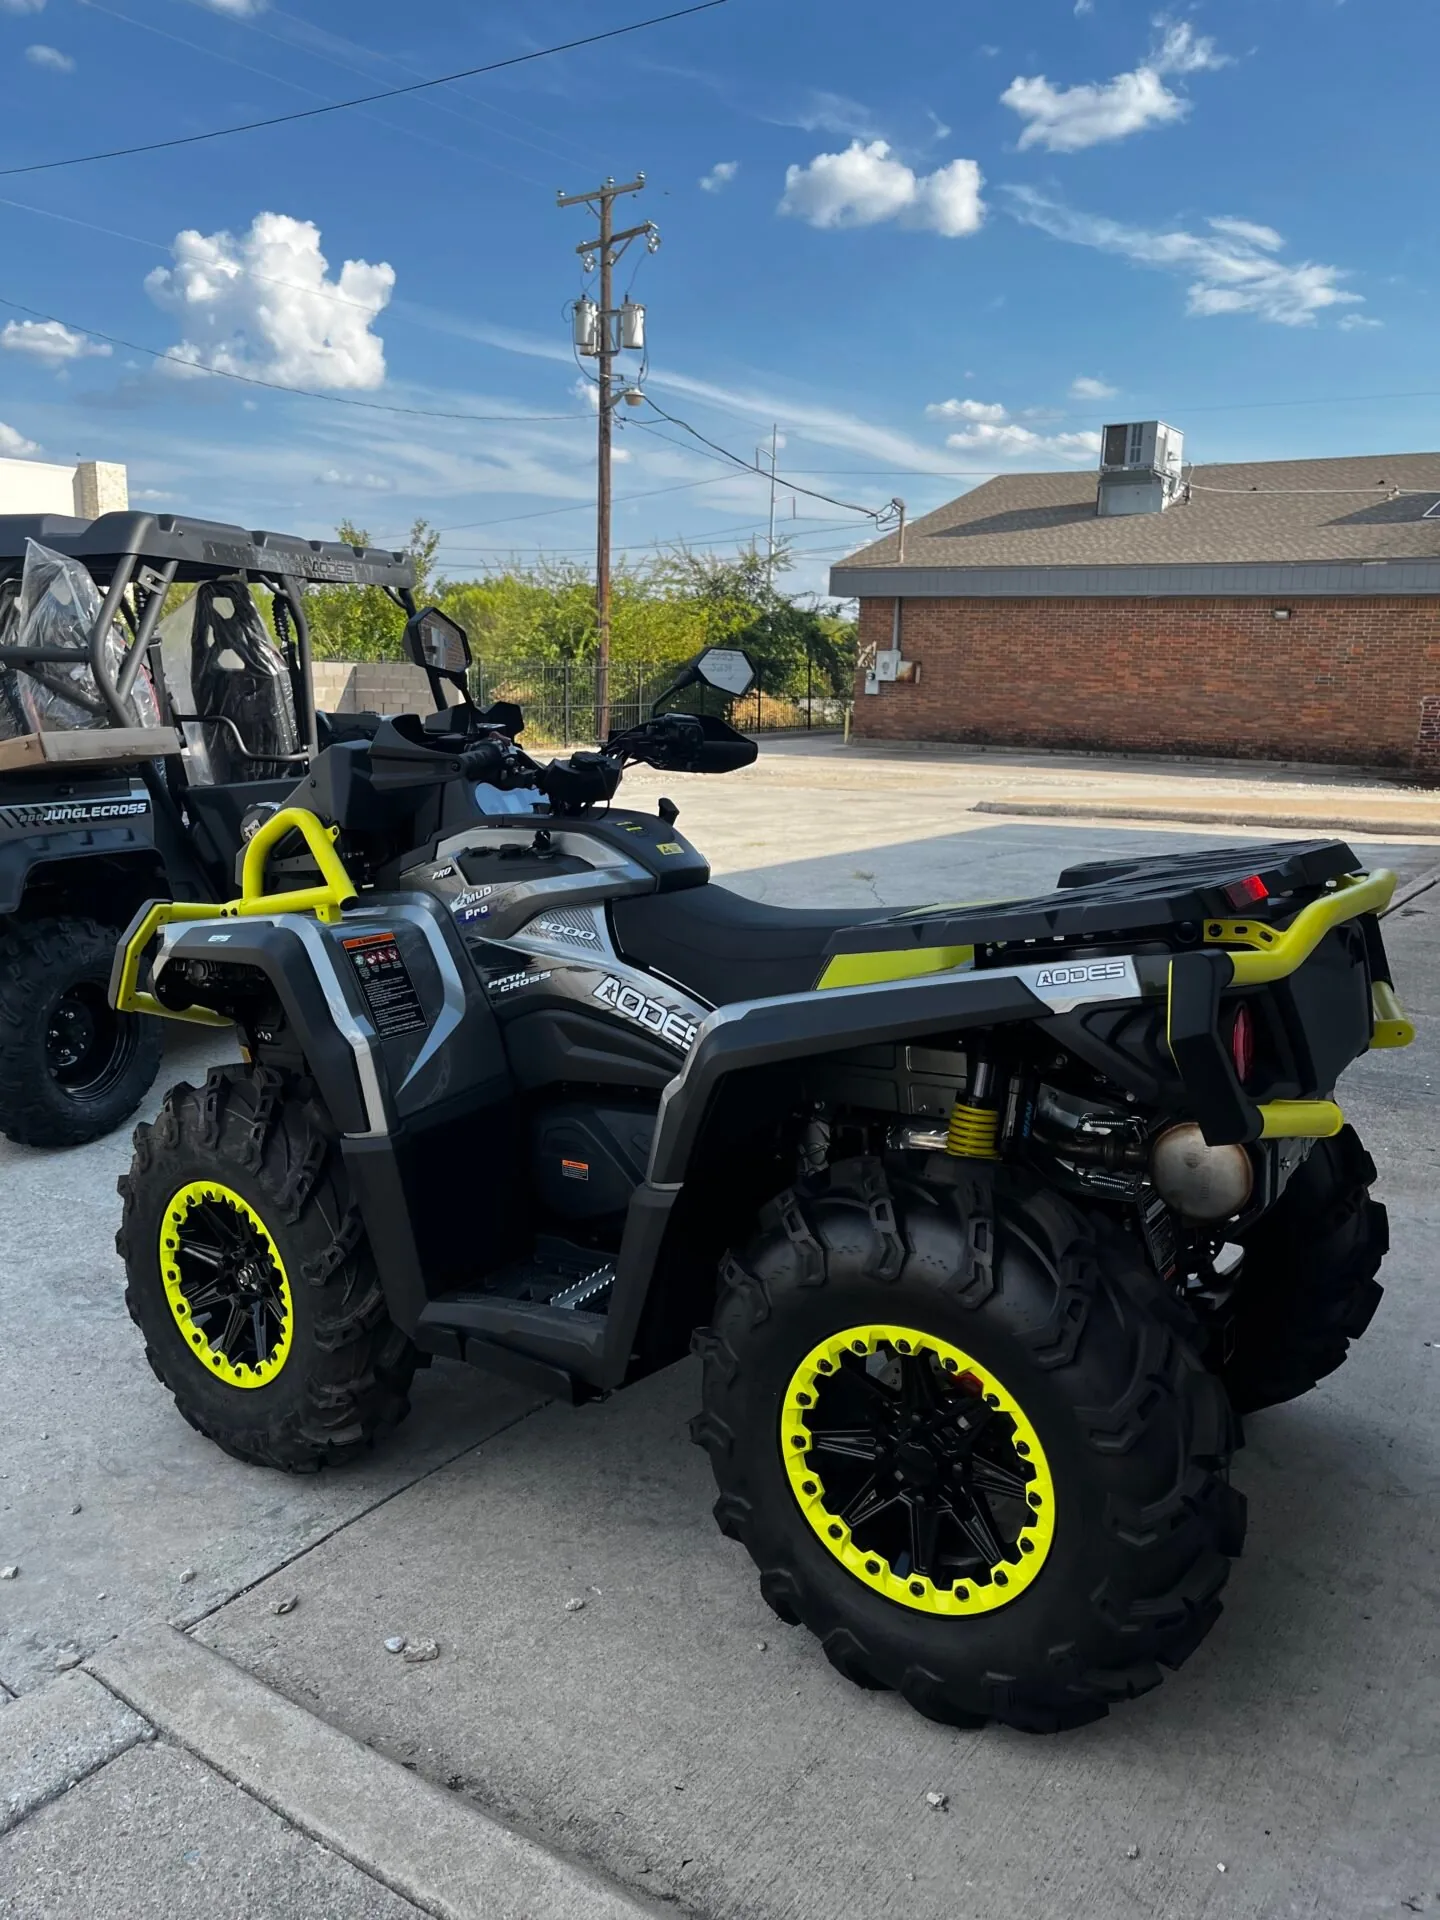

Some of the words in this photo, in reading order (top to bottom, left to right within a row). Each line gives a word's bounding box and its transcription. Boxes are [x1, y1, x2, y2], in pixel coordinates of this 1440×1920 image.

[43, 802, 147, 821] JUNGLECROSS
[432, 866, 452, 880] PRO
[466, 886, 492, 904] MUD
[465, 905, 488, 920] Pro
[540, 921, 596, 940] 1000
[488, 971, 526, 989] PATH
[500, 970, 552, 992] CROSS
[1036, 962, 1125, 987] AODES
